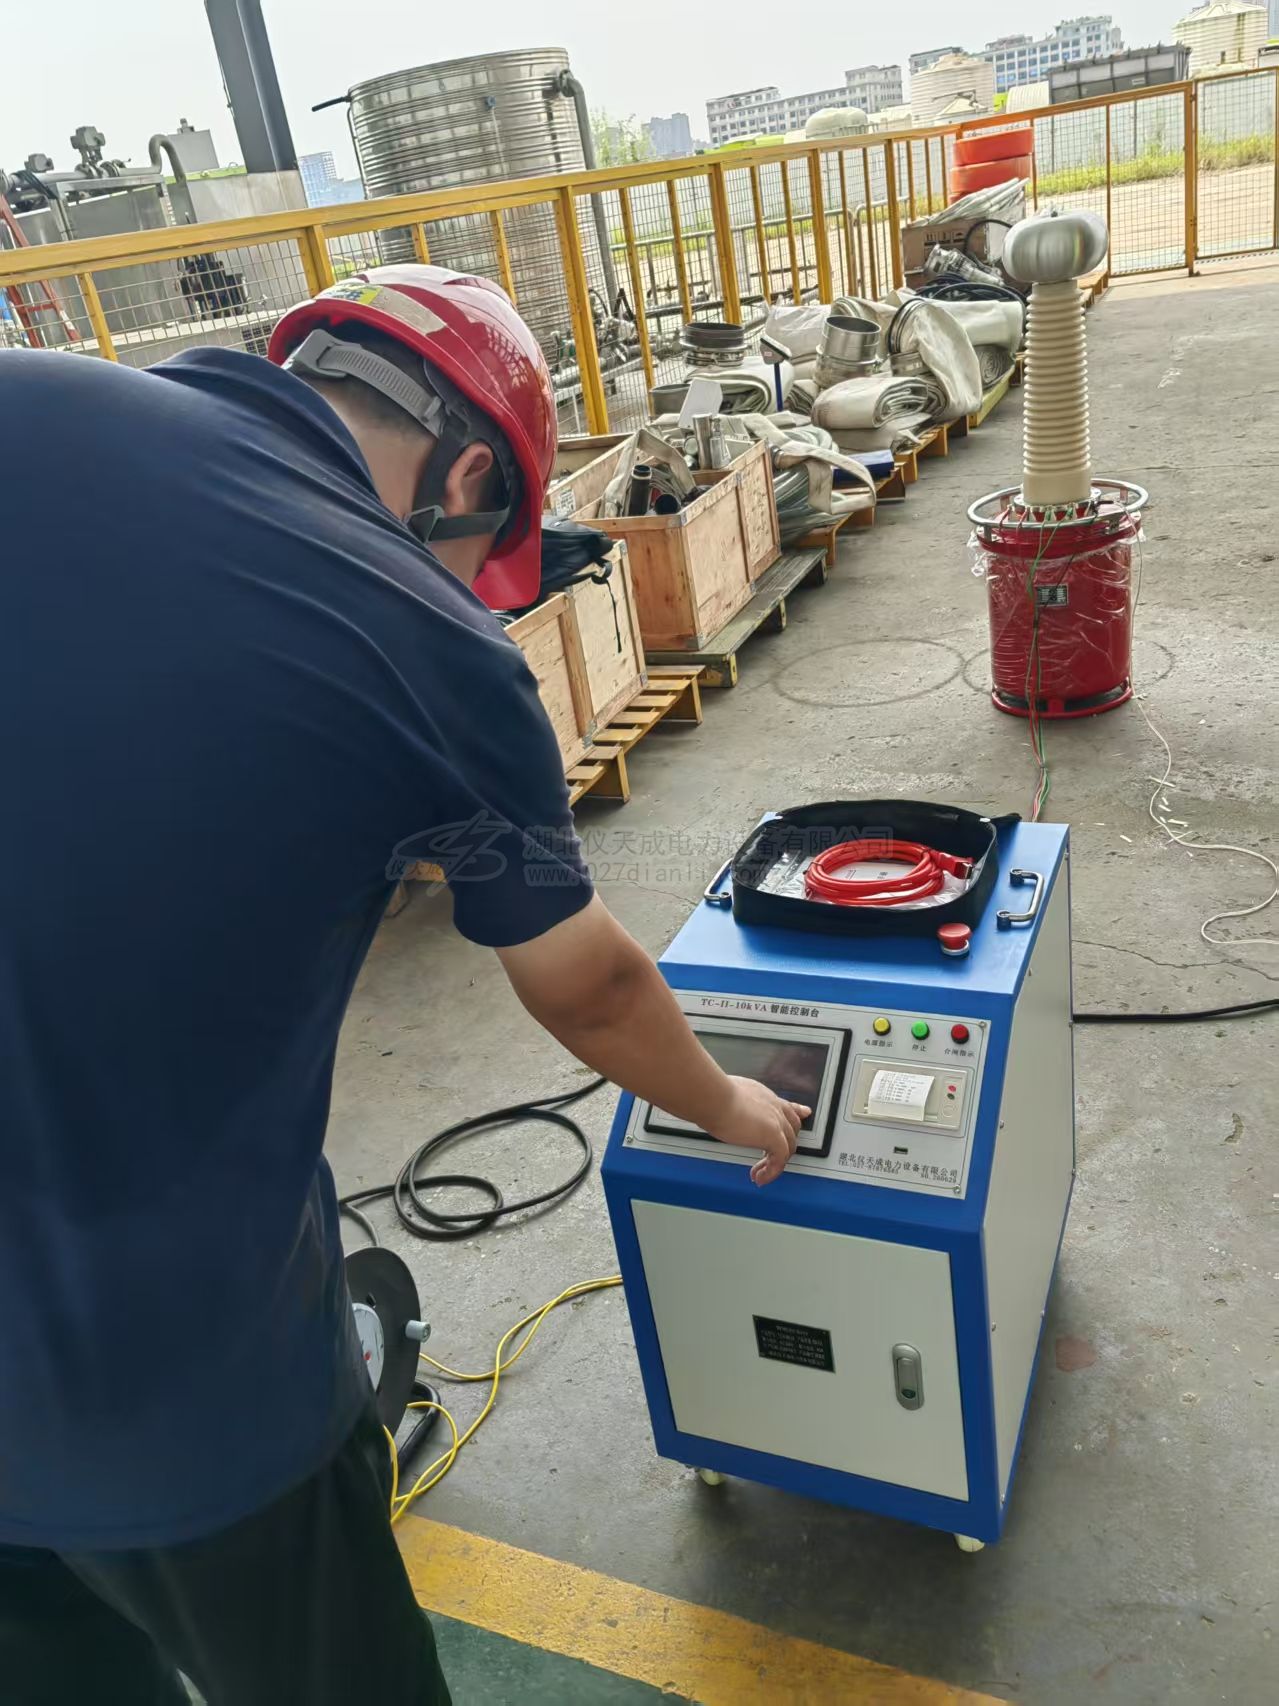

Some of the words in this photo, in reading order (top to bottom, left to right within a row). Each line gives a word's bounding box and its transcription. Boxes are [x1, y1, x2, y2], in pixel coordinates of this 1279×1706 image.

[770, 1003, 820, 1018] 智能控制台
[912, 1044, 927, 1052] 停止
[839, 1152, 958, 1176] 湖北仪天成电力设备有限公司
